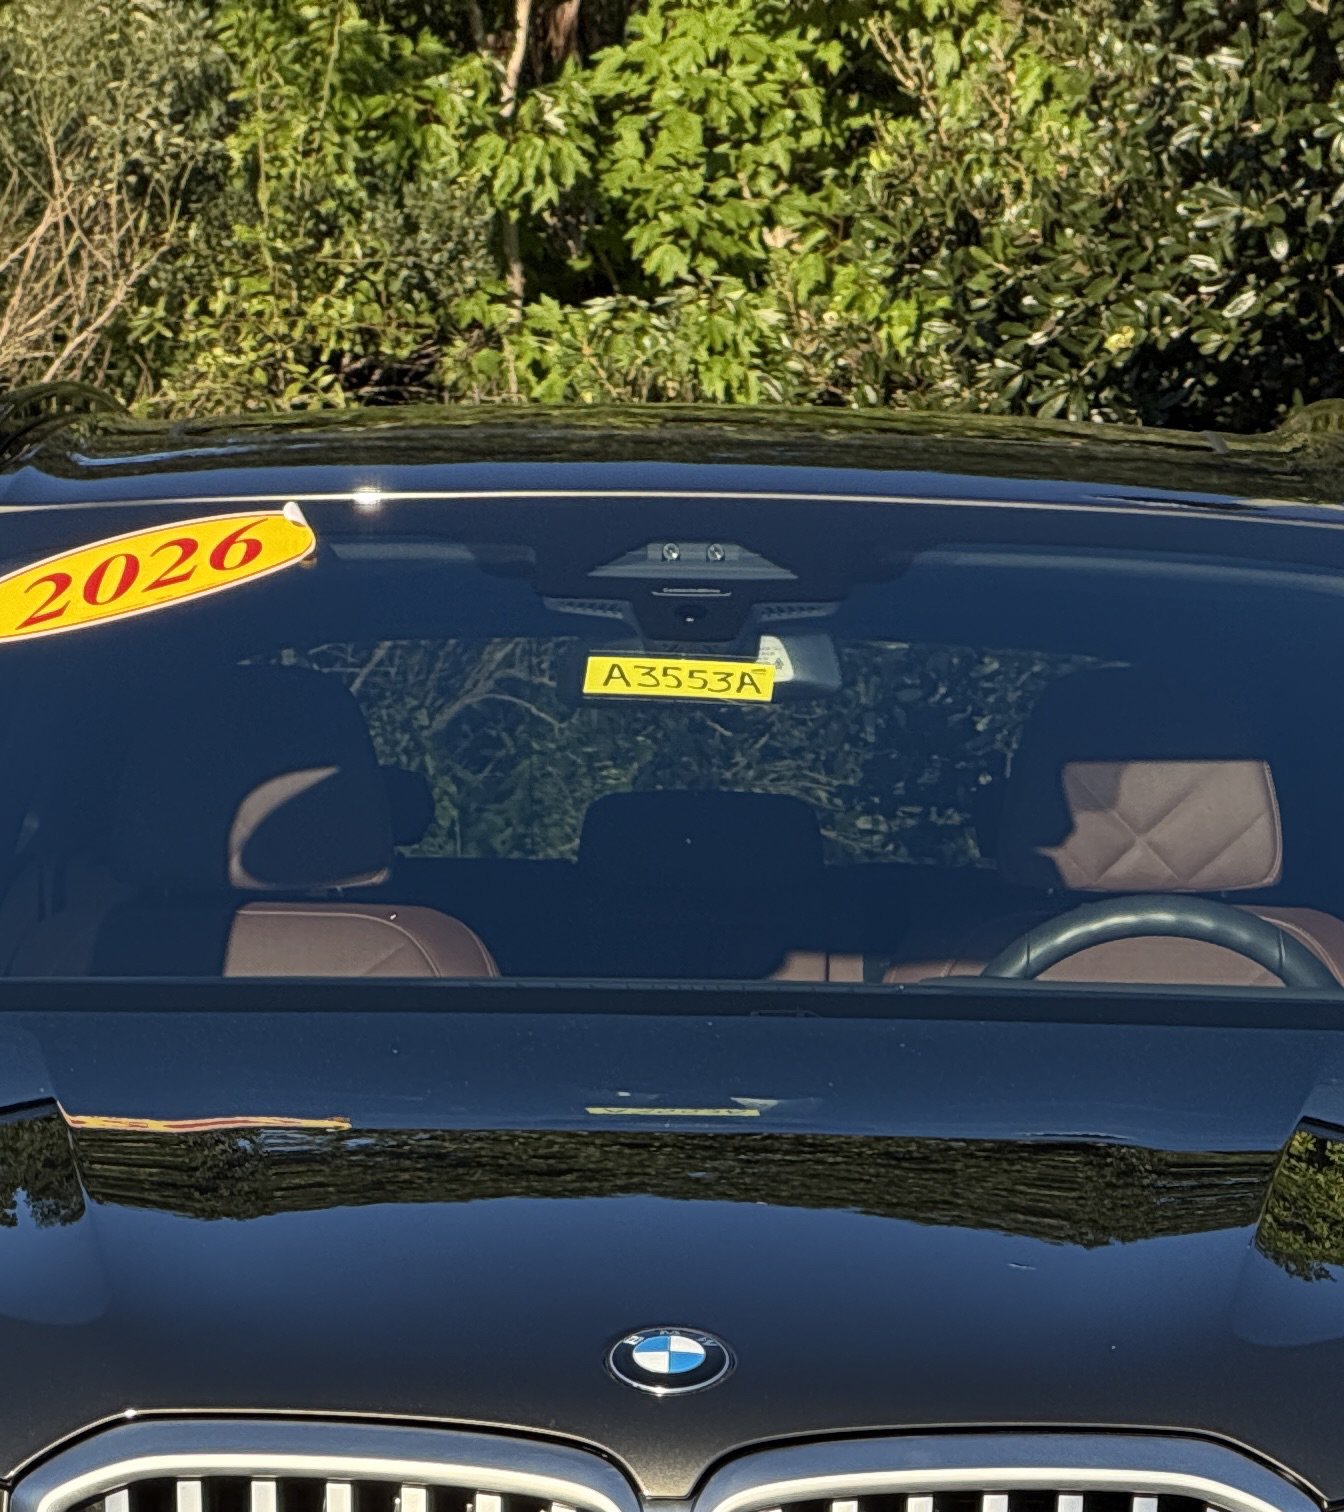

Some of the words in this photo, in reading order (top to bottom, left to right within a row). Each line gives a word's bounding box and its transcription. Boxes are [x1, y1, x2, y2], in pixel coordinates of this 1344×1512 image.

[15, 517, 269, 631] 2026
[602, 663, 762, 694] A3553A
[623, 1329, 719, 1347] BMW
